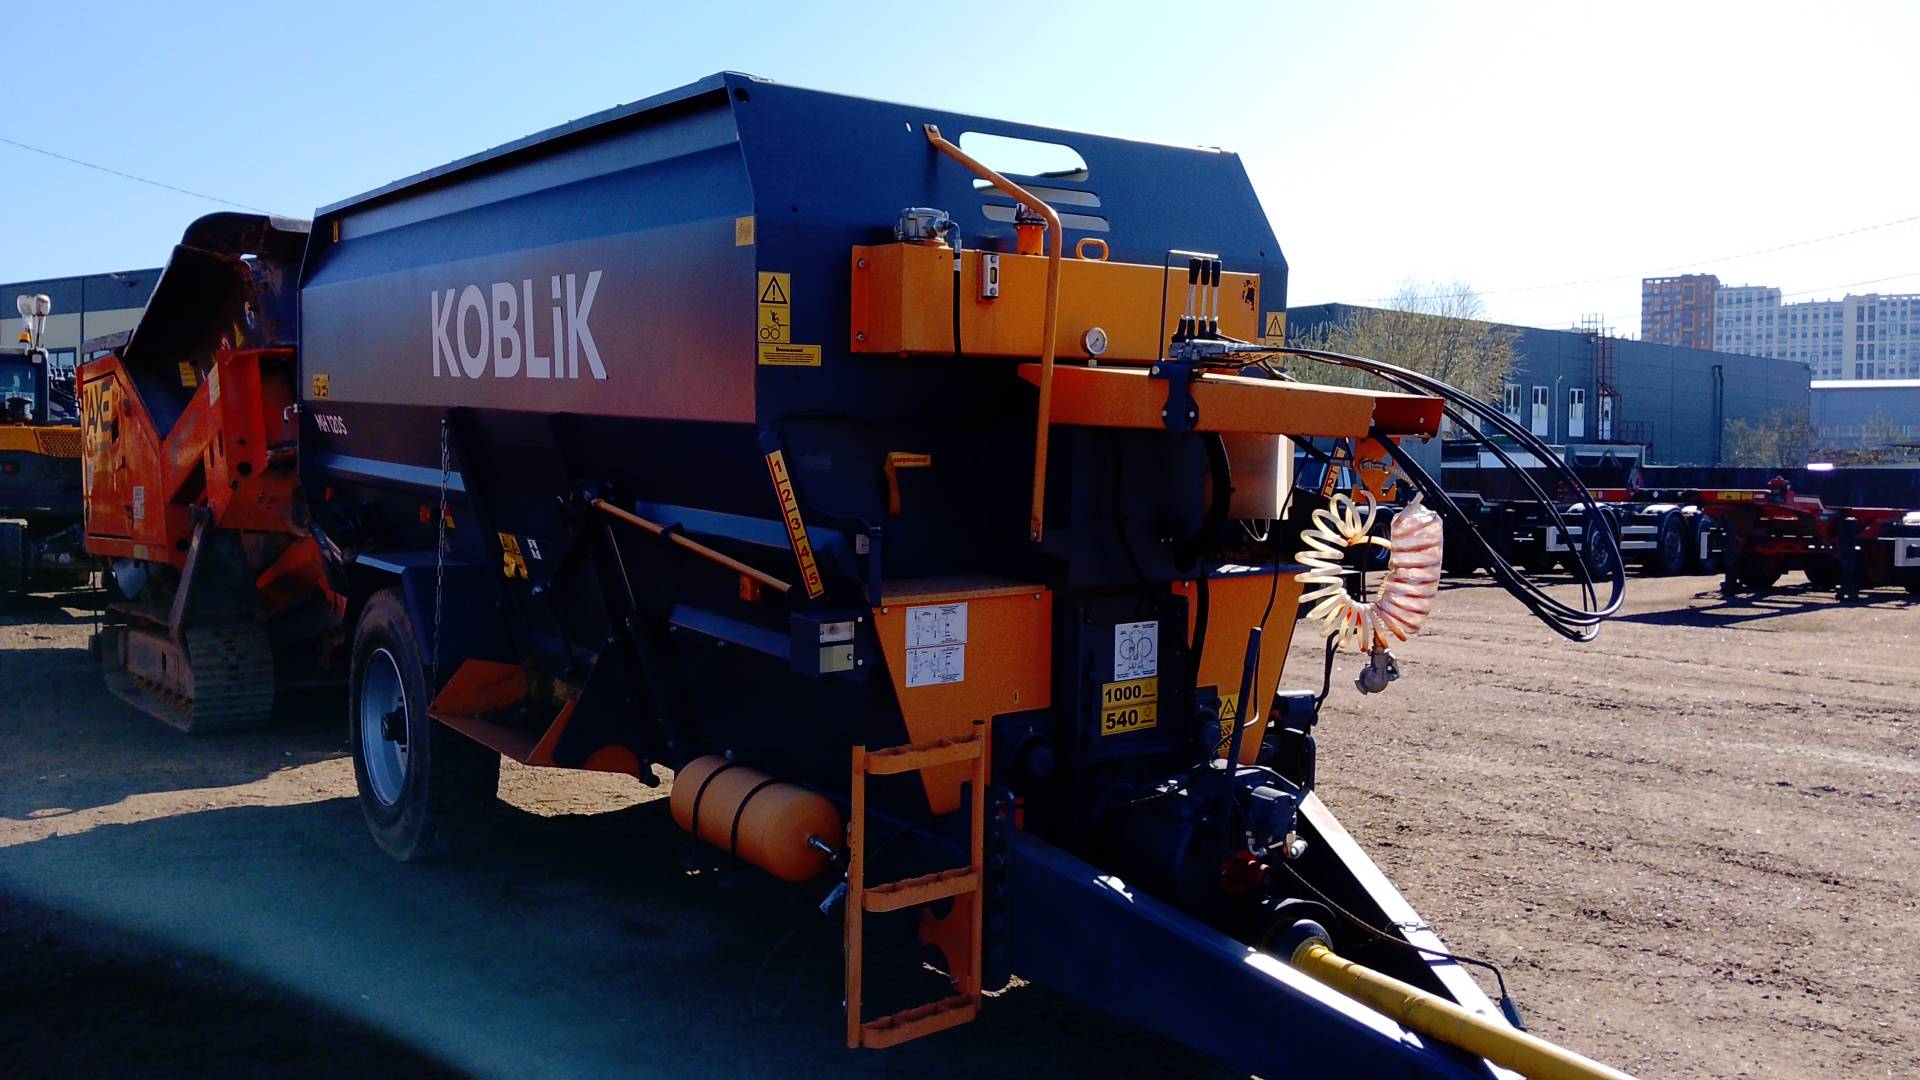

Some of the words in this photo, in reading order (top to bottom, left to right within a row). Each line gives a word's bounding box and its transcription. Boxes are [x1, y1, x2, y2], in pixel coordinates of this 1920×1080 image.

[774, 460, 783, 473] 1
[1326, 477, 1335, 488] 2
[782, 488, 792, 502] 2
[791, 518, 801, 530] 3
[800, 545, 810, 558] 4
[808, 572, 819, 586] 5
[1105, 685, 1141, 703] 1000
[1106, 709, 1138, 730] 540
